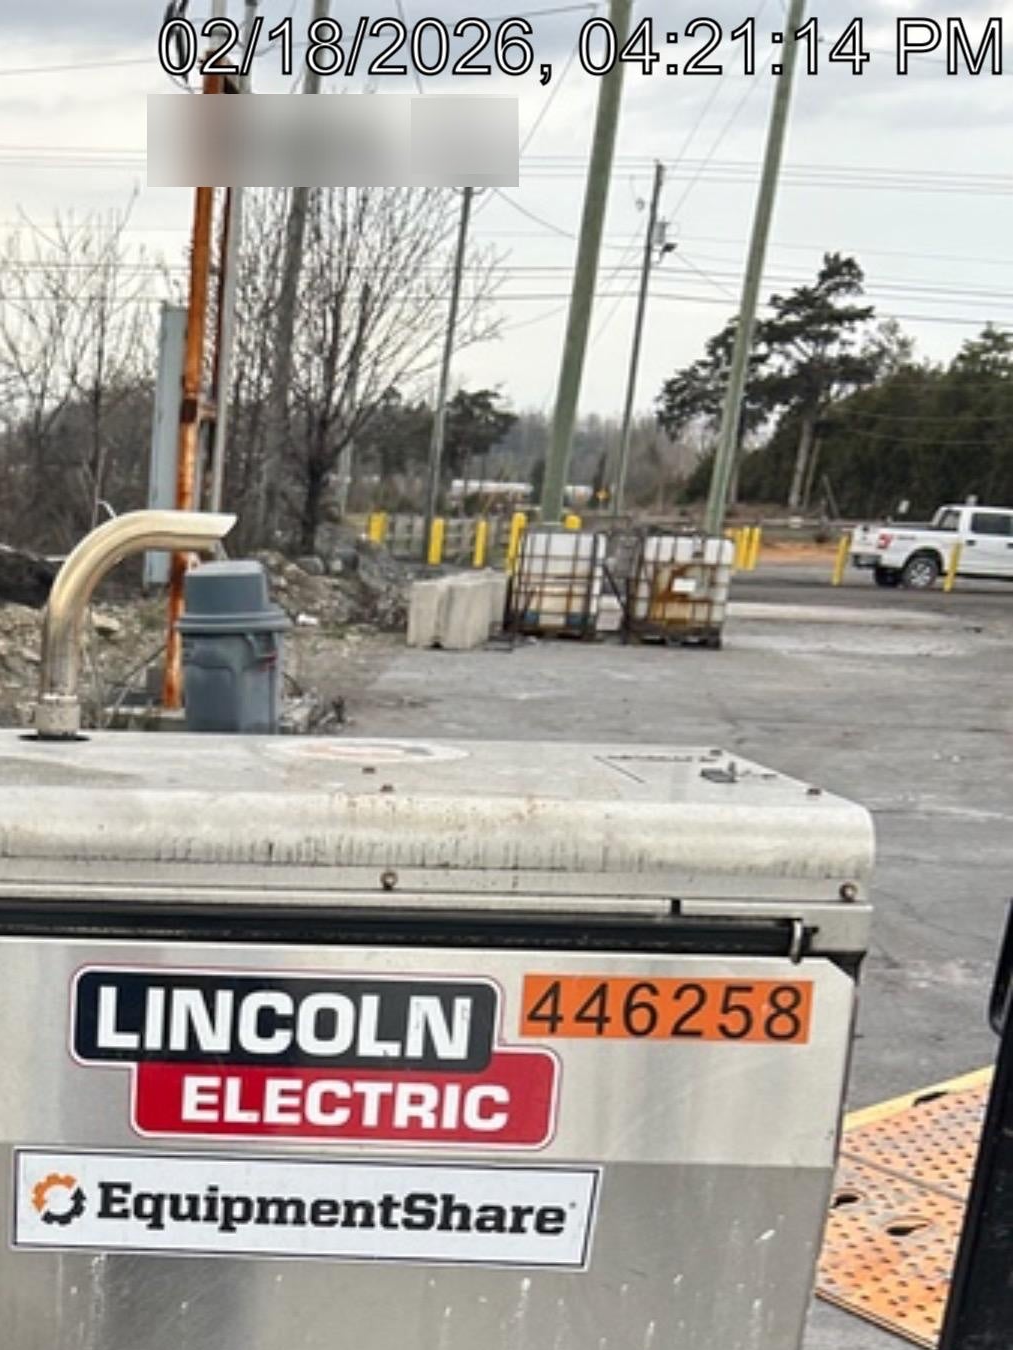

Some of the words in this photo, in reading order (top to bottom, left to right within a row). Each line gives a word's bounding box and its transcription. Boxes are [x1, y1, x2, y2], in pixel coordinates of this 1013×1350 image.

[97, 986, 472, 1060] LINCOLN
[527, 982, 803, 1040] 446258
[181, 1076, 510, 1131] ELECTRIC
[97, 1182, 567, 1236] EquipmentShare
